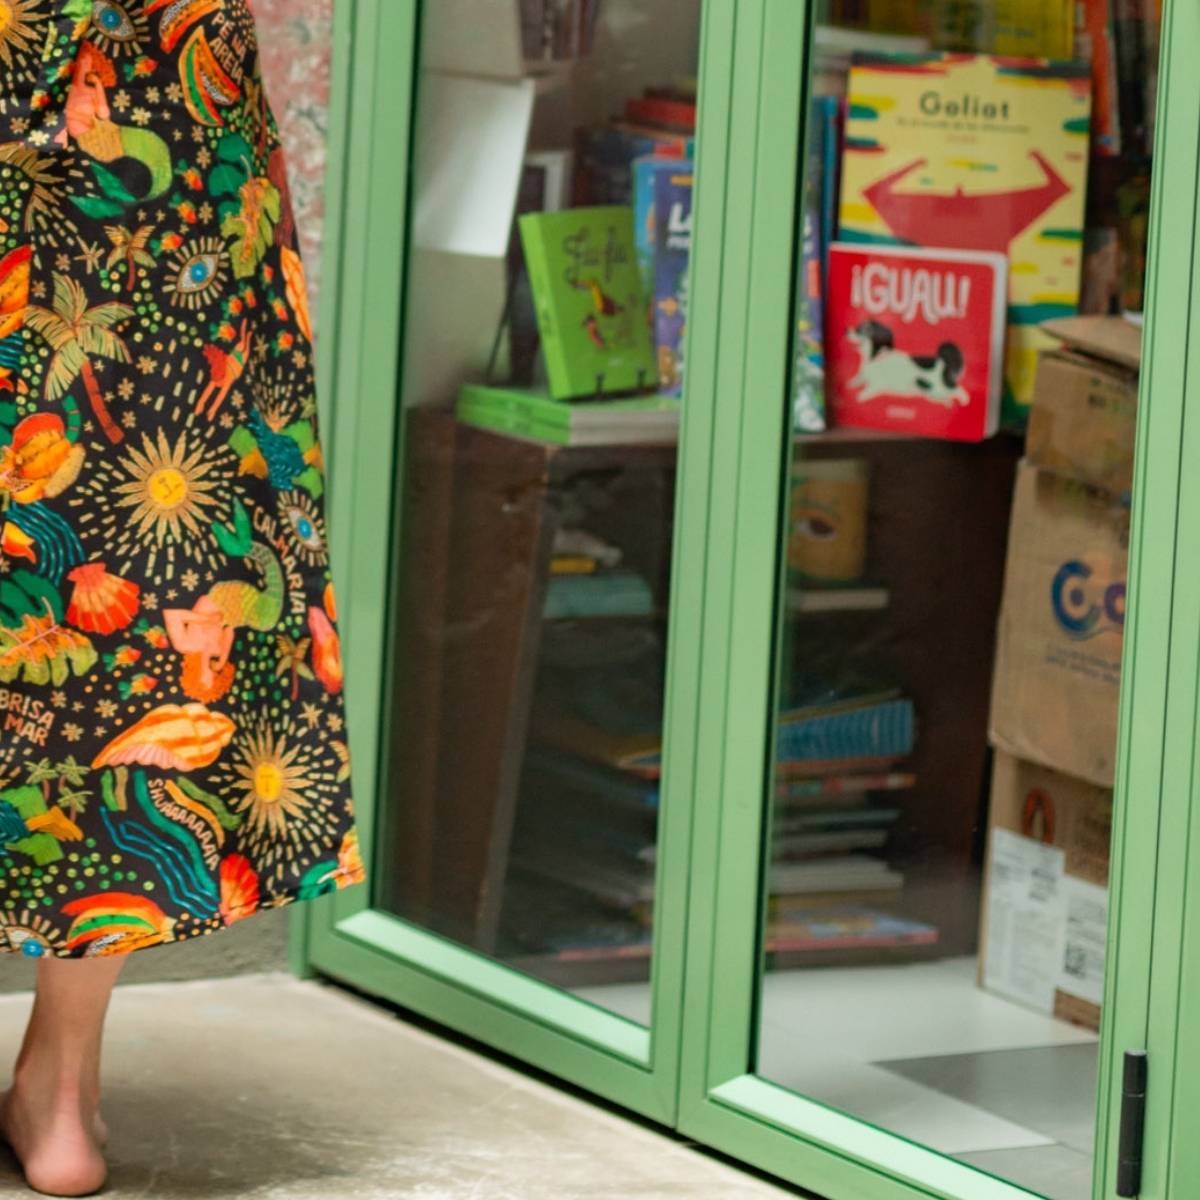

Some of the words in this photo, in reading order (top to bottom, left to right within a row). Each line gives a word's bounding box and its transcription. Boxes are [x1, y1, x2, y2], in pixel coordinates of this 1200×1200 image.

[919, 90, 1010, 120] Goliat
[253, 505, 307, 614] CALMARIA
[3, 712, 49, 747] MAR
